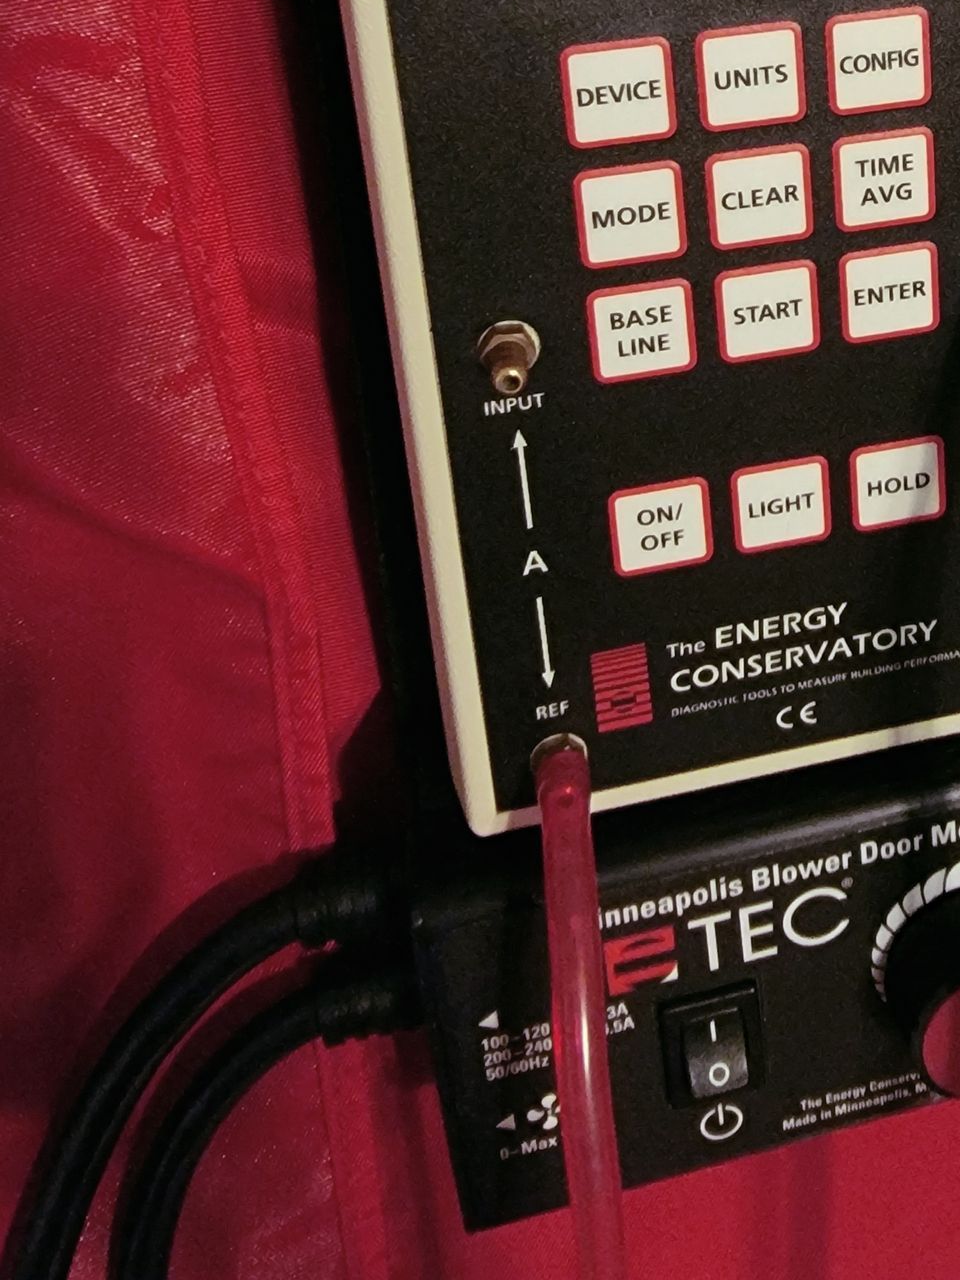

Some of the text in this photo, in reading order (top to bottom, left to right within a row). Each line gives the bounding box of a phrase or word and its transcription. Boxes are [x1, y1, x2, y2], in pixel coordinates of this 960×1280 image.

[838, 47, 920, 75] CONFIG
[713, 64, 788, 91] UNITS
[576, 79, 662, 109] DEVICE
[854, 152, 915, 177] TIME
[720, 183, 800, 210] CLEAR
[859, 181, 913, 206] AVG
[591, 202, 671, 229] MODE
[852, 280, 926, 306] ENTER
[609, 304, 673, 331] BASE
[733, 298, 804, 325] START
[617, 332, 671, 357] LINE
[483, 392, 545, 416] INPUT
[866, 471, 931, 499] HOLD
[635, 502, 683, 527] ON/
[747, 491, 816, 520] LIGHT
[640, 528, 685, 553] OFF
[522, 550, 549, 577] A
[666, 601, 848, 659] The ENERGY
[670, 619, 938, 693] CONSERVATORY
[671, 694, 739, 718] DIAGNOSTIC
[742, 686, 777, 703] TOOLS
[780, 681, 796, 696] TO
[798, 671, 848, 691] MEASURE
[851, 662, 902, 680] BUILDING
[536, 700, 570, 721] REF
[598, 876, 744, 931] inneapolis
[751, 847, 852, 894] Blower
[860, 833, 924, 867] Door
[800, 1097, 822, 1111] The
[825, 1086, 866, 1105] Energy
[782, 1114, 817, 1131] Made
[820, 1107, 832, 1120] in
